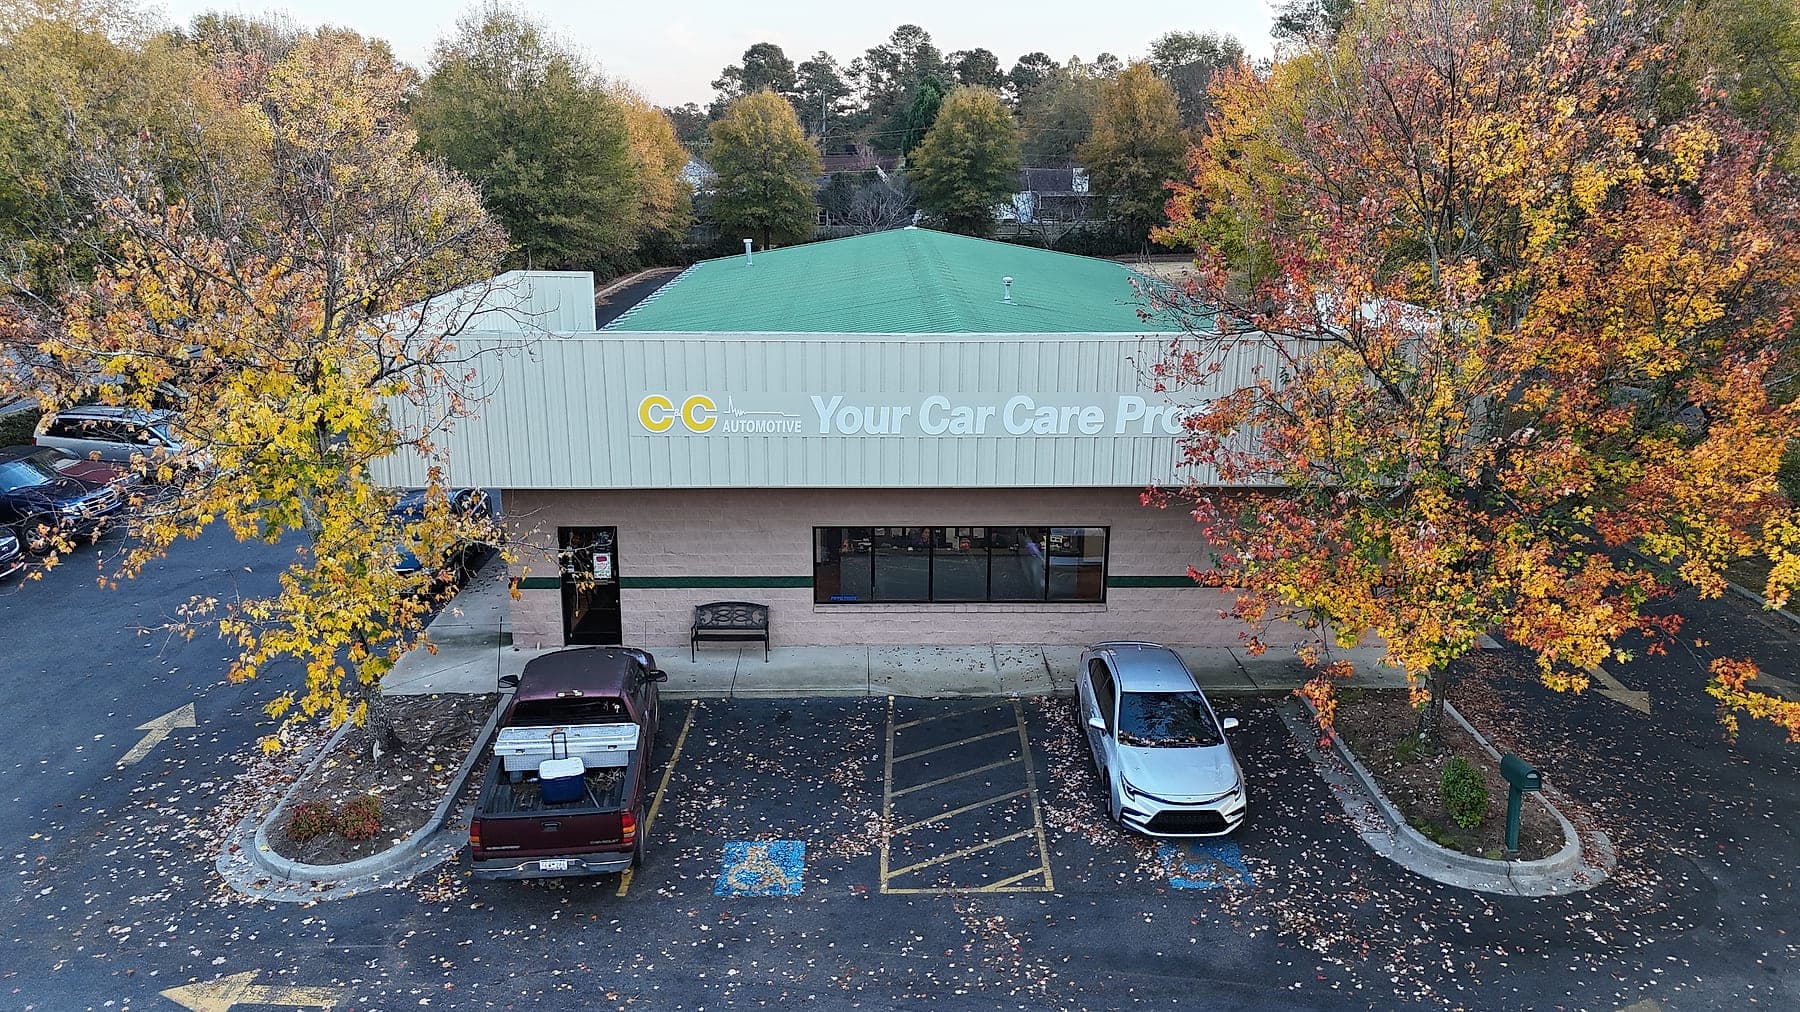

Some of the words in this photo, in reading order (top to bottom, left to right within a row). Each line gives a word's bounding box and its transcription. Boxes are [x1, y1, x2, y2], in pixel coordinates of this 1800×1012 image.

[638, 394, 717, 433] C&C
[722, 419, 802, 433] AUTOMOTIVE
[810, 395, 911, 435] Your
[919, 395, 996, 435] Car
[1003, 395, 1105, 435] Care
